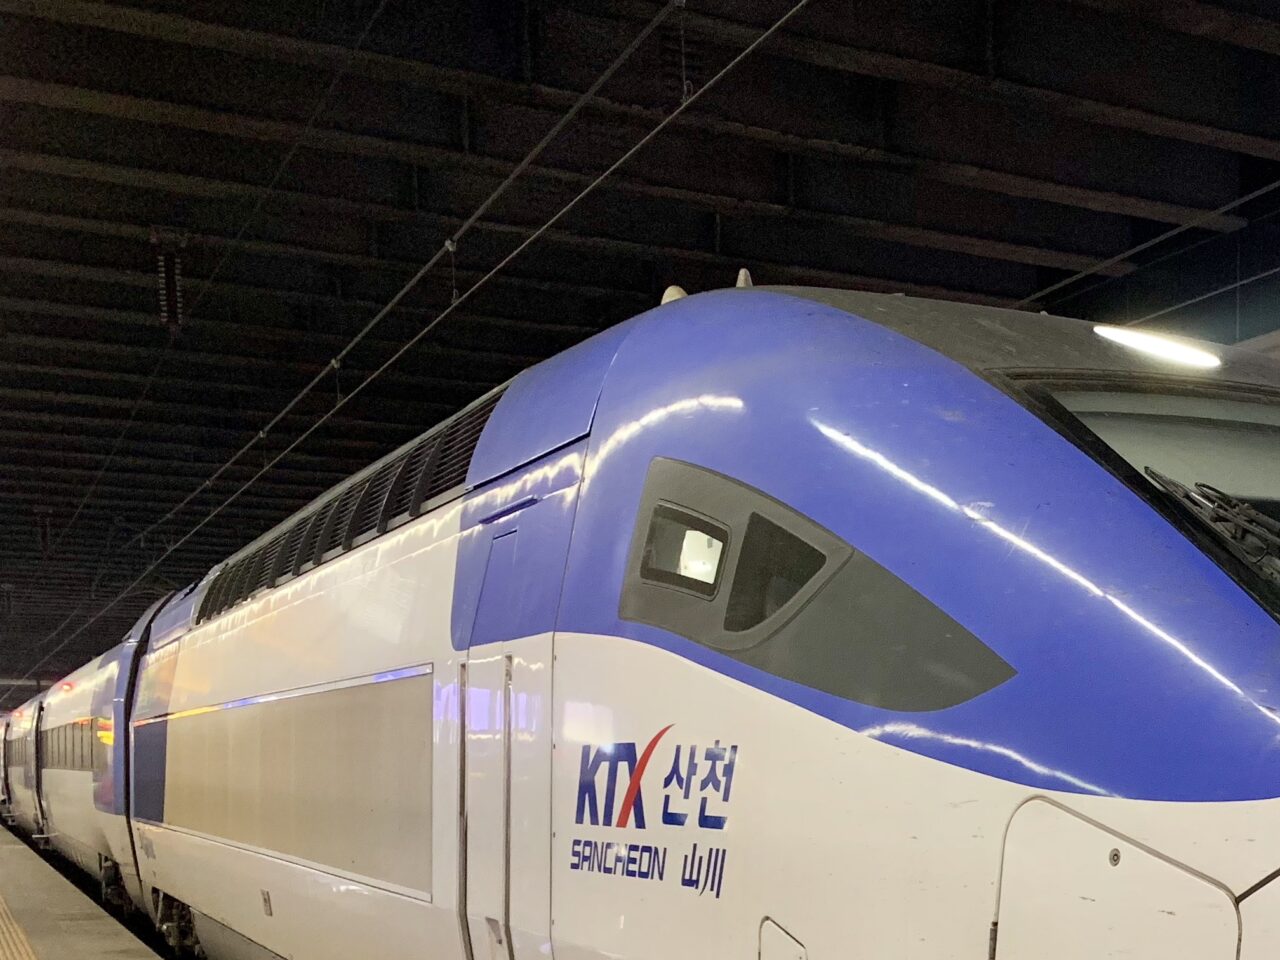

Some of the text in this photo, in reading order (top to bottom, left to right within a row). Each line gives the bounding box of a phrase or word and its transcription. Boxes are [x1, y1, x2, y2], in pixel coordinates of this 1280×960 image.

[574, 723, 738, 830] KTX 산천
[570, 839, 727, 898] SANCHEON 山川
